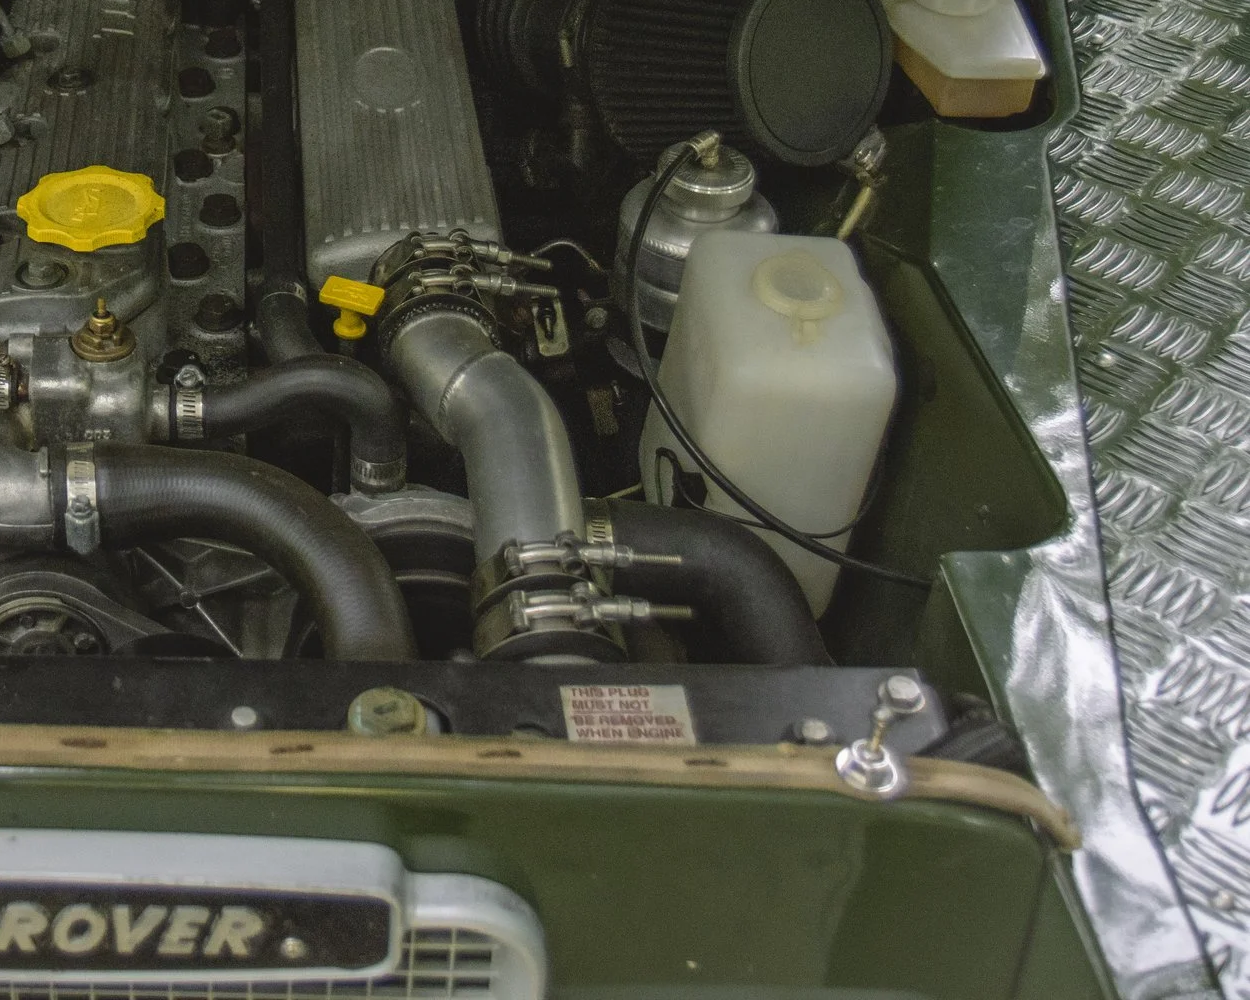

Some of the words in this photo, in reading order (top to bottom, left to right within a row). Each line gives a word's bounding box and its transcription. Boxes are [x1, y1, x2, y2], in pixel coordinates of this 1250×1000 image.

[571, 686, 604, 698] THIS
[608, 686, 650, 698] PLUG
[571, 699, 613, 711] MUST
[618, 699, 650, 711] NOT
[572, 715, 595, 727] BE
[598, 715, 678, 727] REMOVED
[575, 728, 623, 739] WHEN
[626, 727, 684, 739] ENGINE
